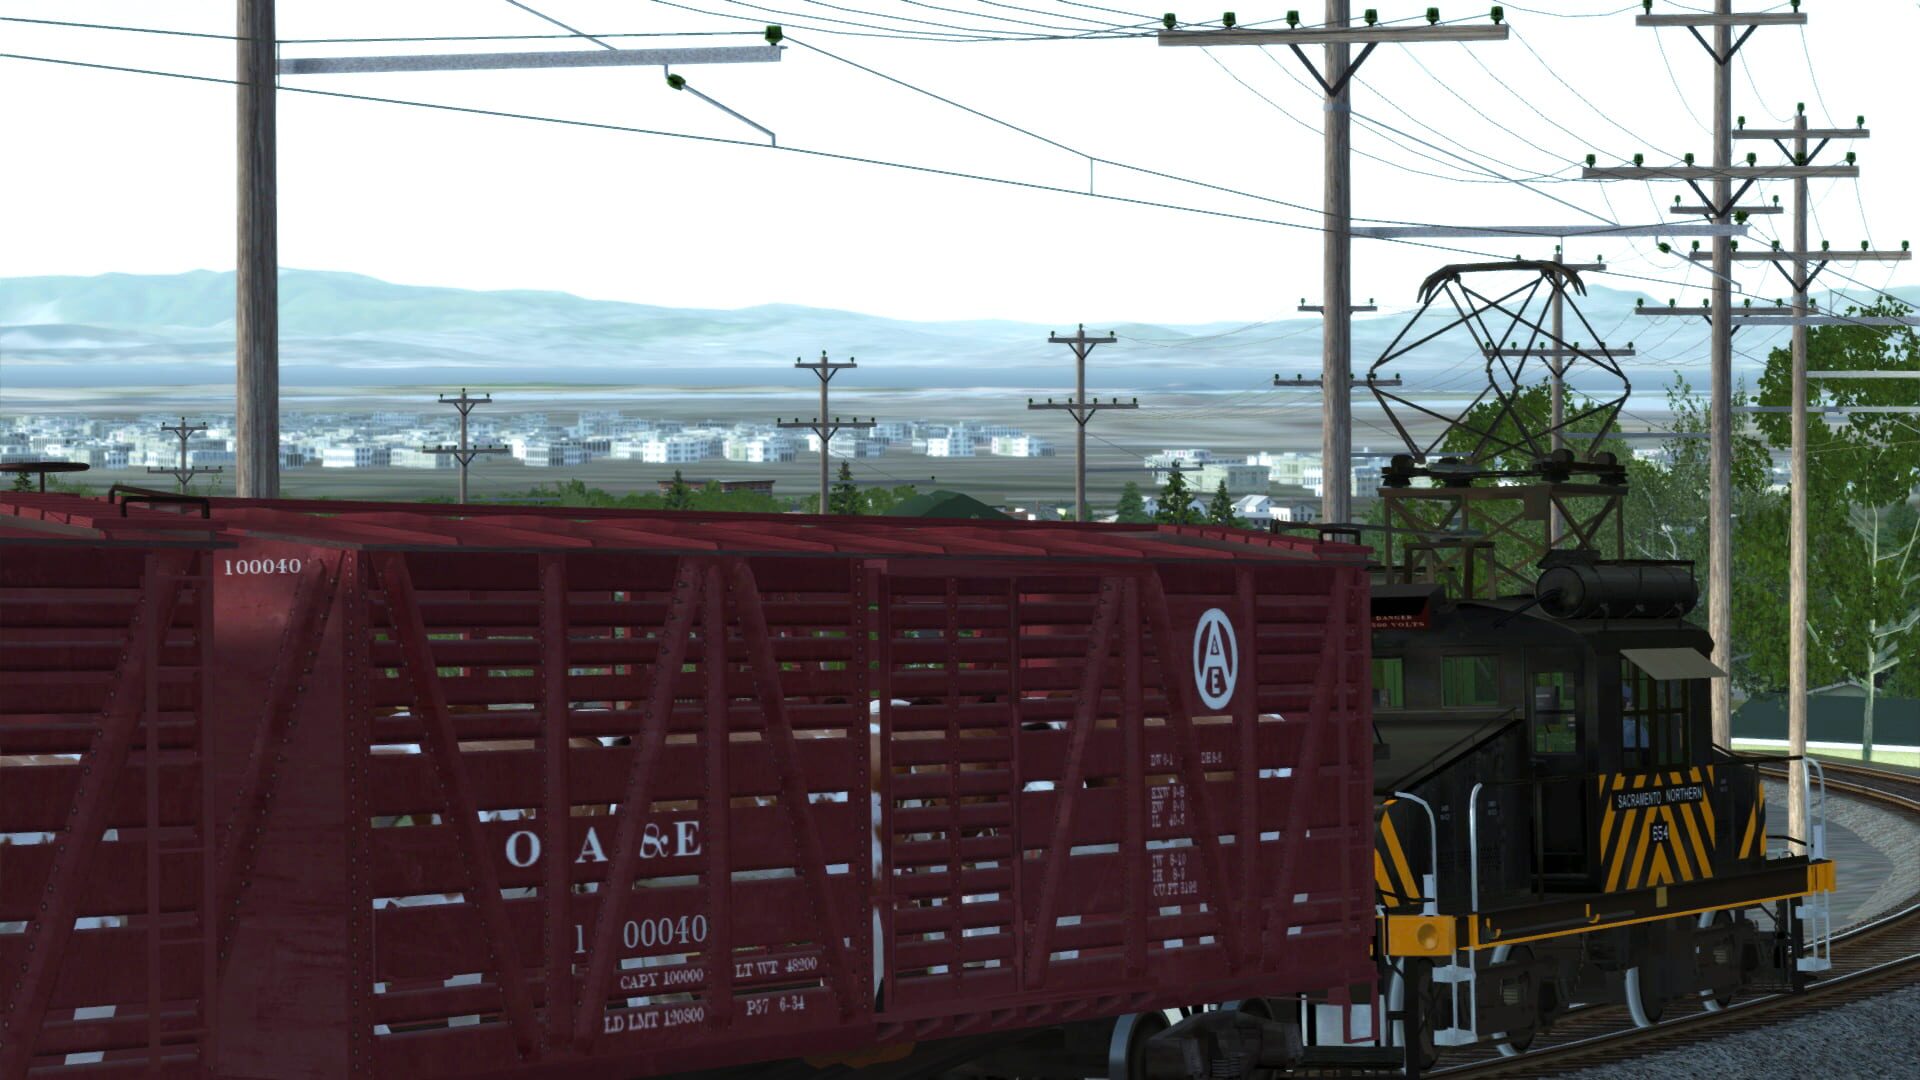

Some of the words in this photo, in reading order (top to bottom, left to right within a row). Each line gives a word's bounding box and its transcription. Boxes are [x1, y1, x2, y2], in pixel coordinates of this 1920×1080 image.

[224, 558, 302, 576] 100040
[1617, 791, 1662, 808] SACRAMENTO
[1665, 786, 1702, 802] NORTHERN
[1652, 825, 1669, 841] 654
[505, 830, 541, 867] O
[574, 826, 608, 863] A
[620, 972, 659, 990] CAPY
[663, 968, 704, 985] 100000
[735, 962, 754, 978] LT
[757, 960, 778, 976] WT
[604, 1015, 624, 1034] LD
[628, 1011, 659, 1031] LMT
[663, 1007, 704, 1027] 120800
